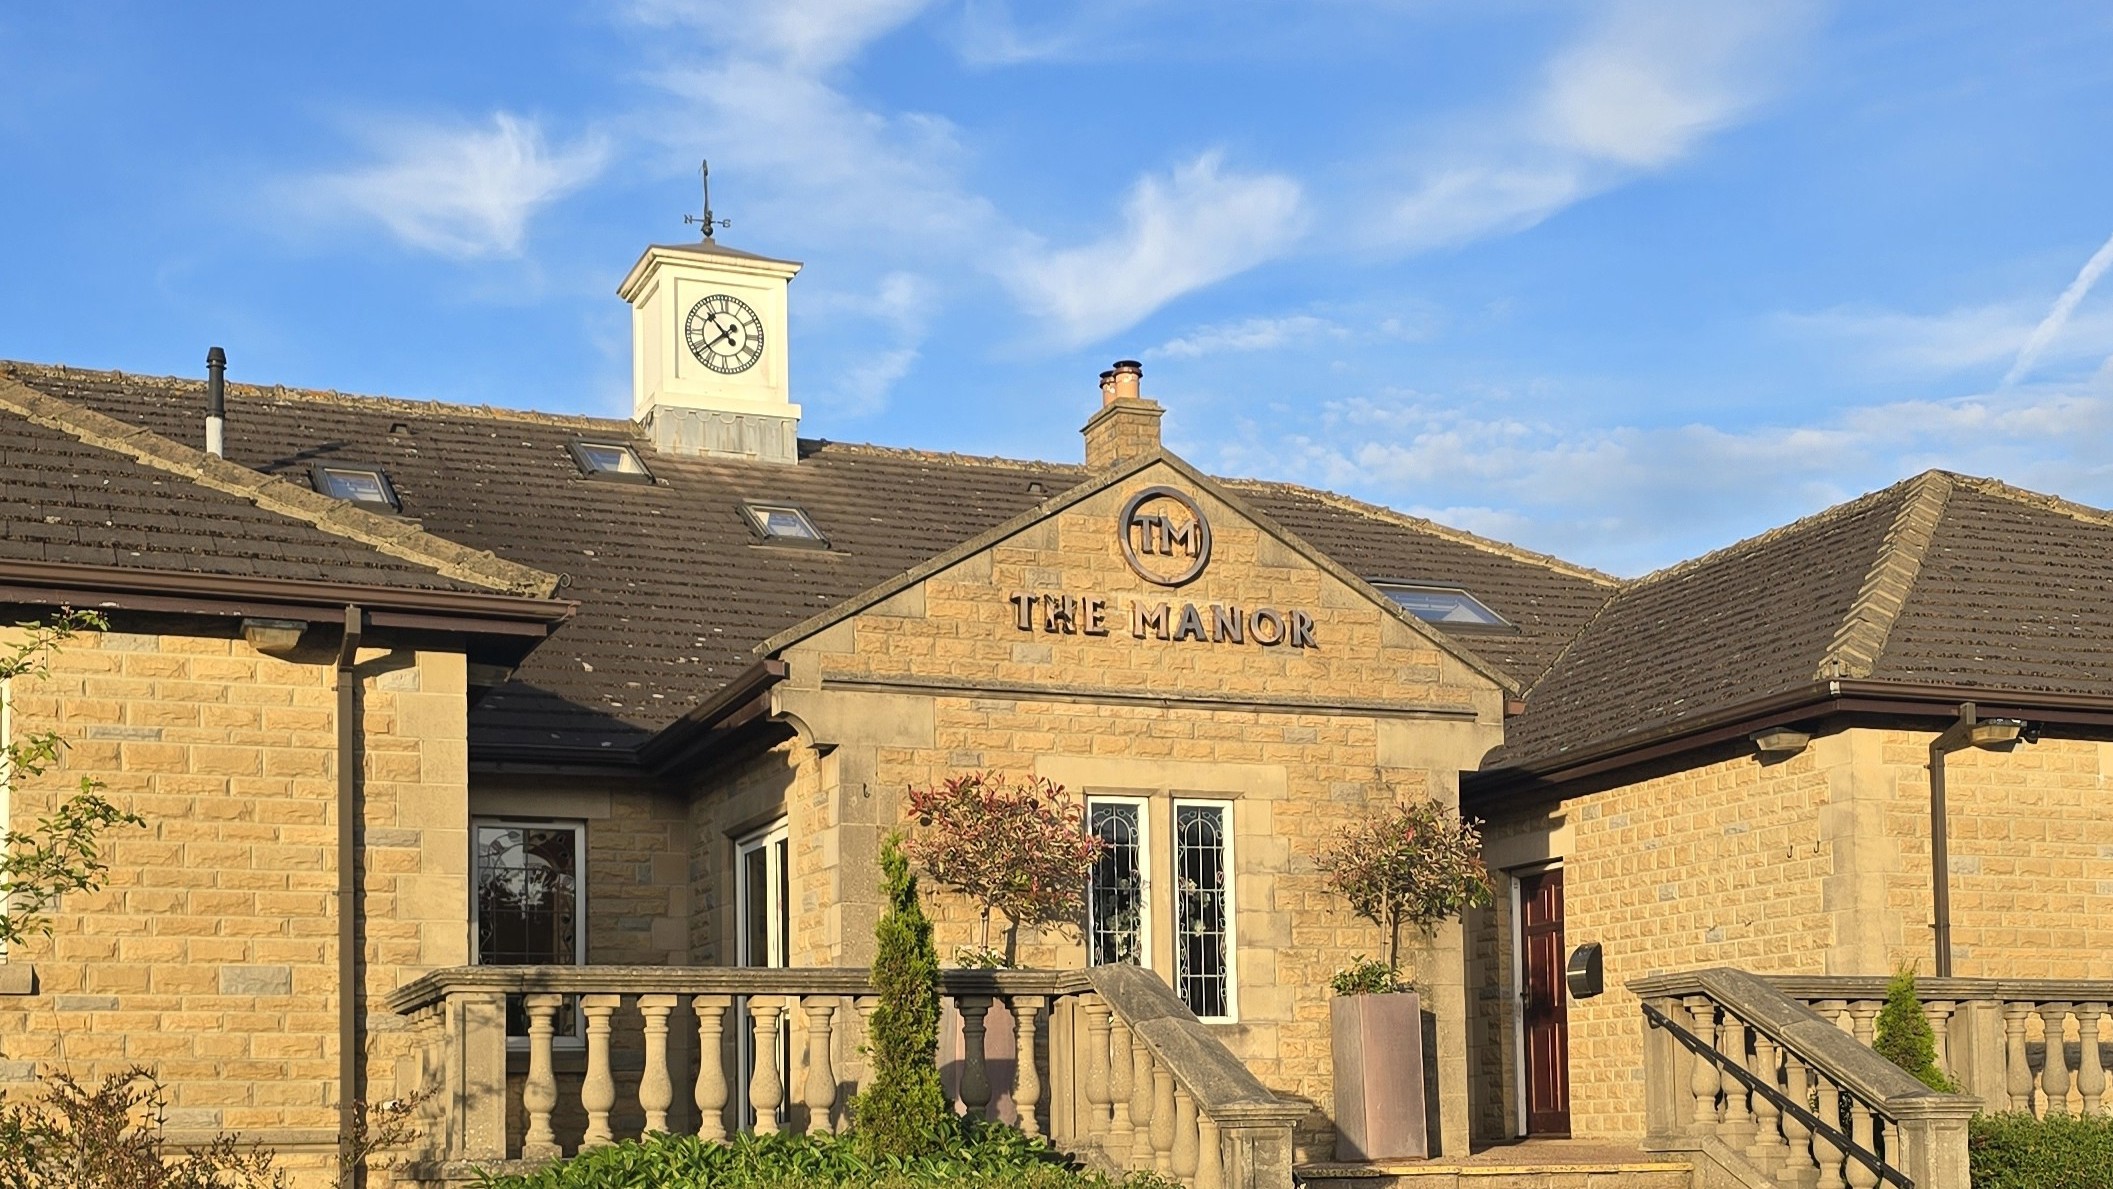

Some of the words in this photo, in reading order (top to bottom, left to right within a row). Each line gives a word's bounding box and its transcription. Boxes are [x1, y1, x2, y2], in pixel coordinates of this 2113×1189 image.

[684, 214, 692, 224] N
[1131, 515, 1200, 556] TM
[1010, 591, 1109, 637] THE
[1131, 599, 1319, 649] MANOR
